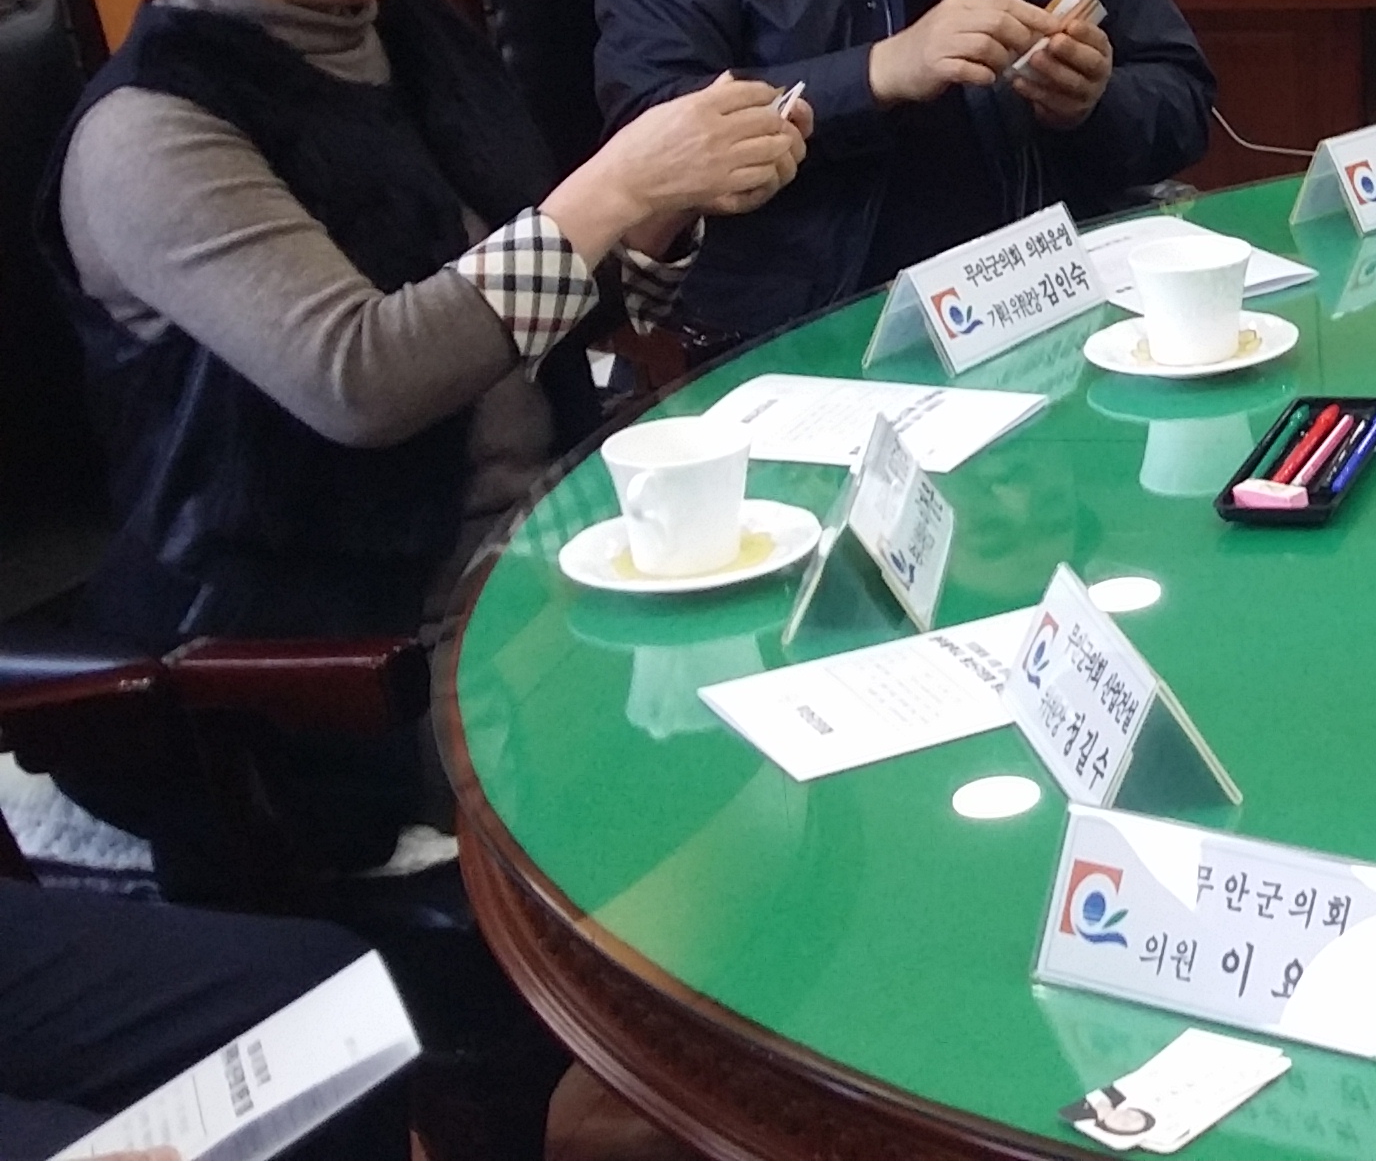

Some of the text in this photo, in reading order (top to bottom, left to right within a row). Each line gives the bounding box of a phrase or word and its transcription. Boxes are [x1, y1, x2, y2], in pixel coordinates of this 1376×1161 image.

[963, 222, 1073, 287] 무안군의회 의회운영
[1038, 261, 1090, 307] 김인숙
[1100, 672, 1140, 735] 산업건설
[1063, 712, 1110, 790] 정길수
[1196, 864, 1352, 936] 무안군의회
[1139, 931, 1198, 982] 의원
